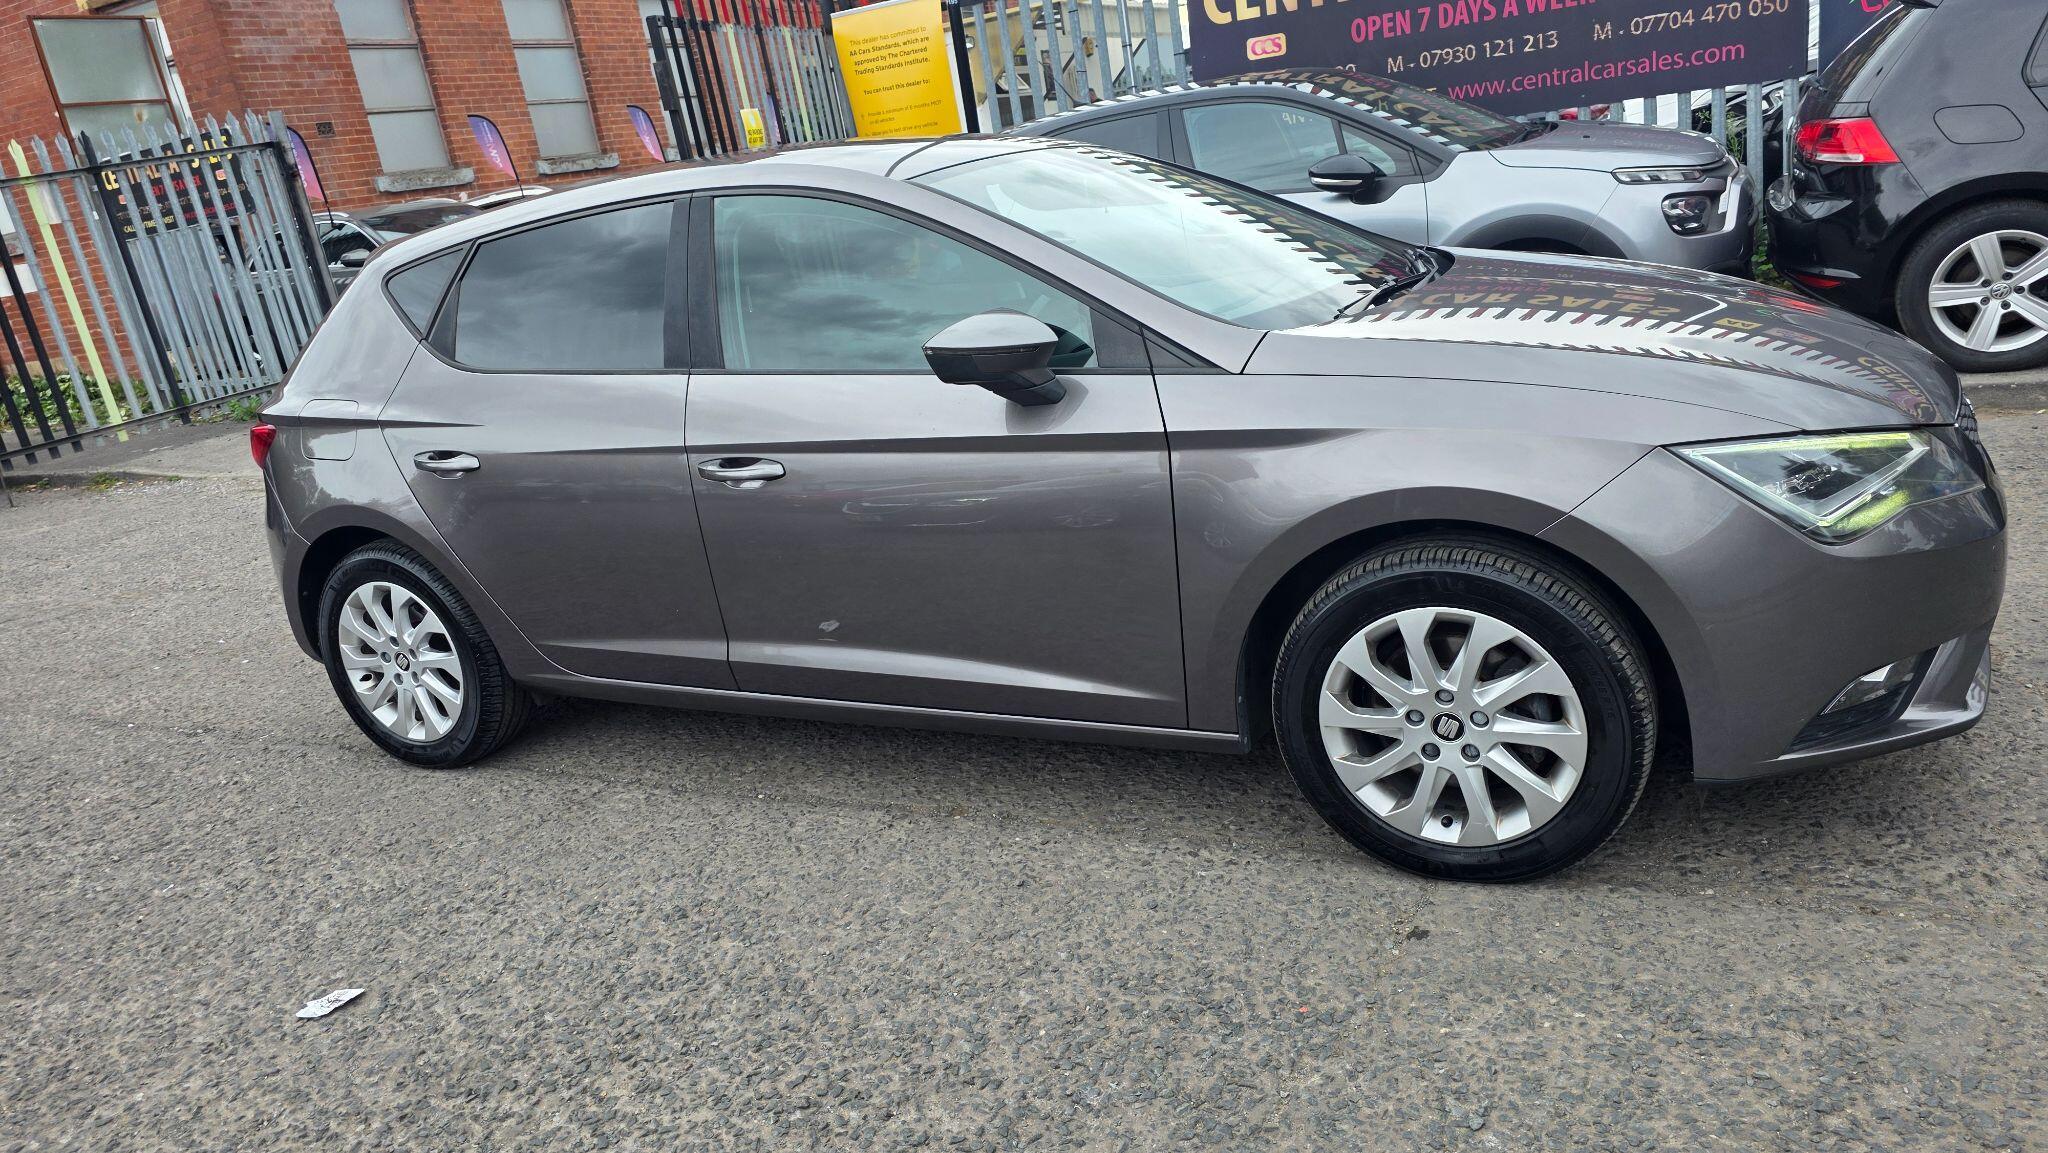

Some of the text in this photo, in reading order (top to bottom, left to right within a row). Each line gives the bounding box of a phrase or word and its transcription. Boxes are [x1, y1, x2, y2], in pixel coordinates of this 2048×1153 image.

[1350, 8, 1411, 43] OPEN
[1416, 7, 1431, 32] 7
[1438, 0, 1497, 29] DAYS
[1502, 0, 1519, 18] A
[850, 39, 860, 47] This
[862, 36, 878, 45] dealer
[890, 27, 920, 39] committed
[858, 47, 871, 55] Cars
[872, 42, 902, 53] Standards,
[902, 38, 920, 46] which
[1387, 56, 1403, 74] M
[1419, 44, 1476, 69] 07930
[1483, 38, 1515, 58] 121
[1522, 30, 1559, 53] 213
[1592, 21, 1613, 41] M
[1630, 10, 1696, 36] 07704
[1701, 2, 1742, 24] 470
[1749, 0, 1789, 17] 050
[854, 56, 880, 66] approved
[880, 54, 887, 62] by
[900, 46, 928, 57] Chartered
[854, 66, 875, 76] Trading
[876, 62, 904, 72] Standards
[1448, 42, 1745, 101] www.centralcarsales.com
[882, 84, 896, 92] trust
[896, 82, 905, 90] this
[906, 80, 922, 88] dealer
